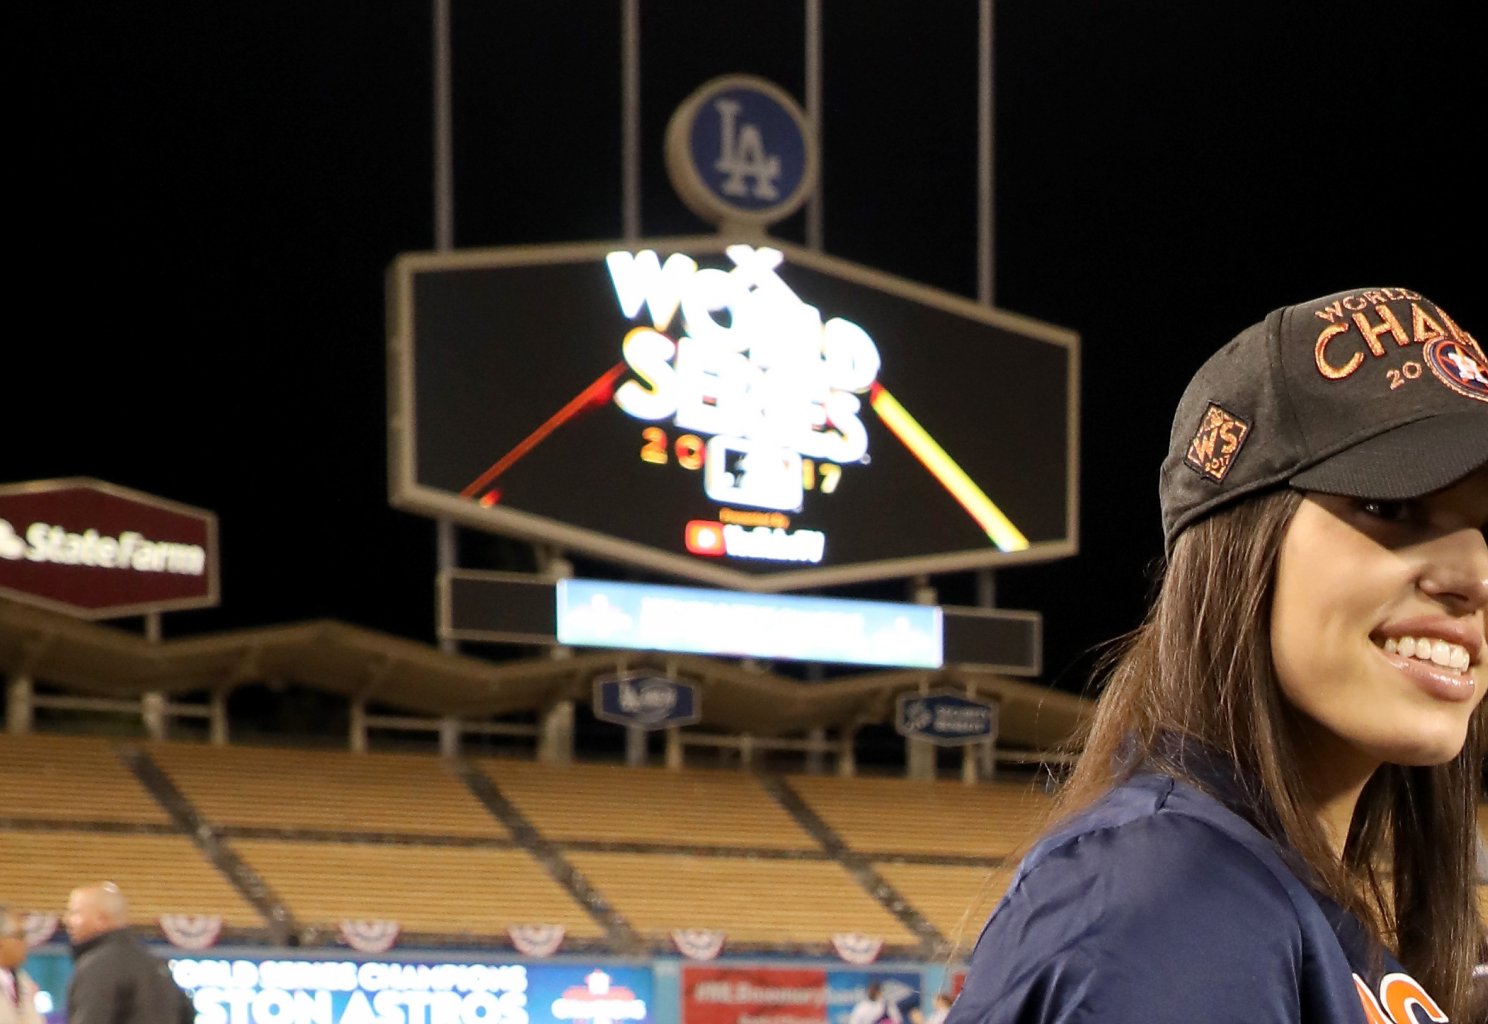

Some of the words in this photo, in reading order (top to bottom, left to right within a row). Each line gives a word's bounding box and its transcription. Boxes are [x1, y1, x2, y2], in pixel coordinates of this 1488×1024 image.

[714, 99, 781, 200] LA
[1386, 361, 1422, 390] 20
[640, 426, 706, 468] 20
[168, 959, 258, 990] ORLD
[259, 961, 358, 991] SERIES
